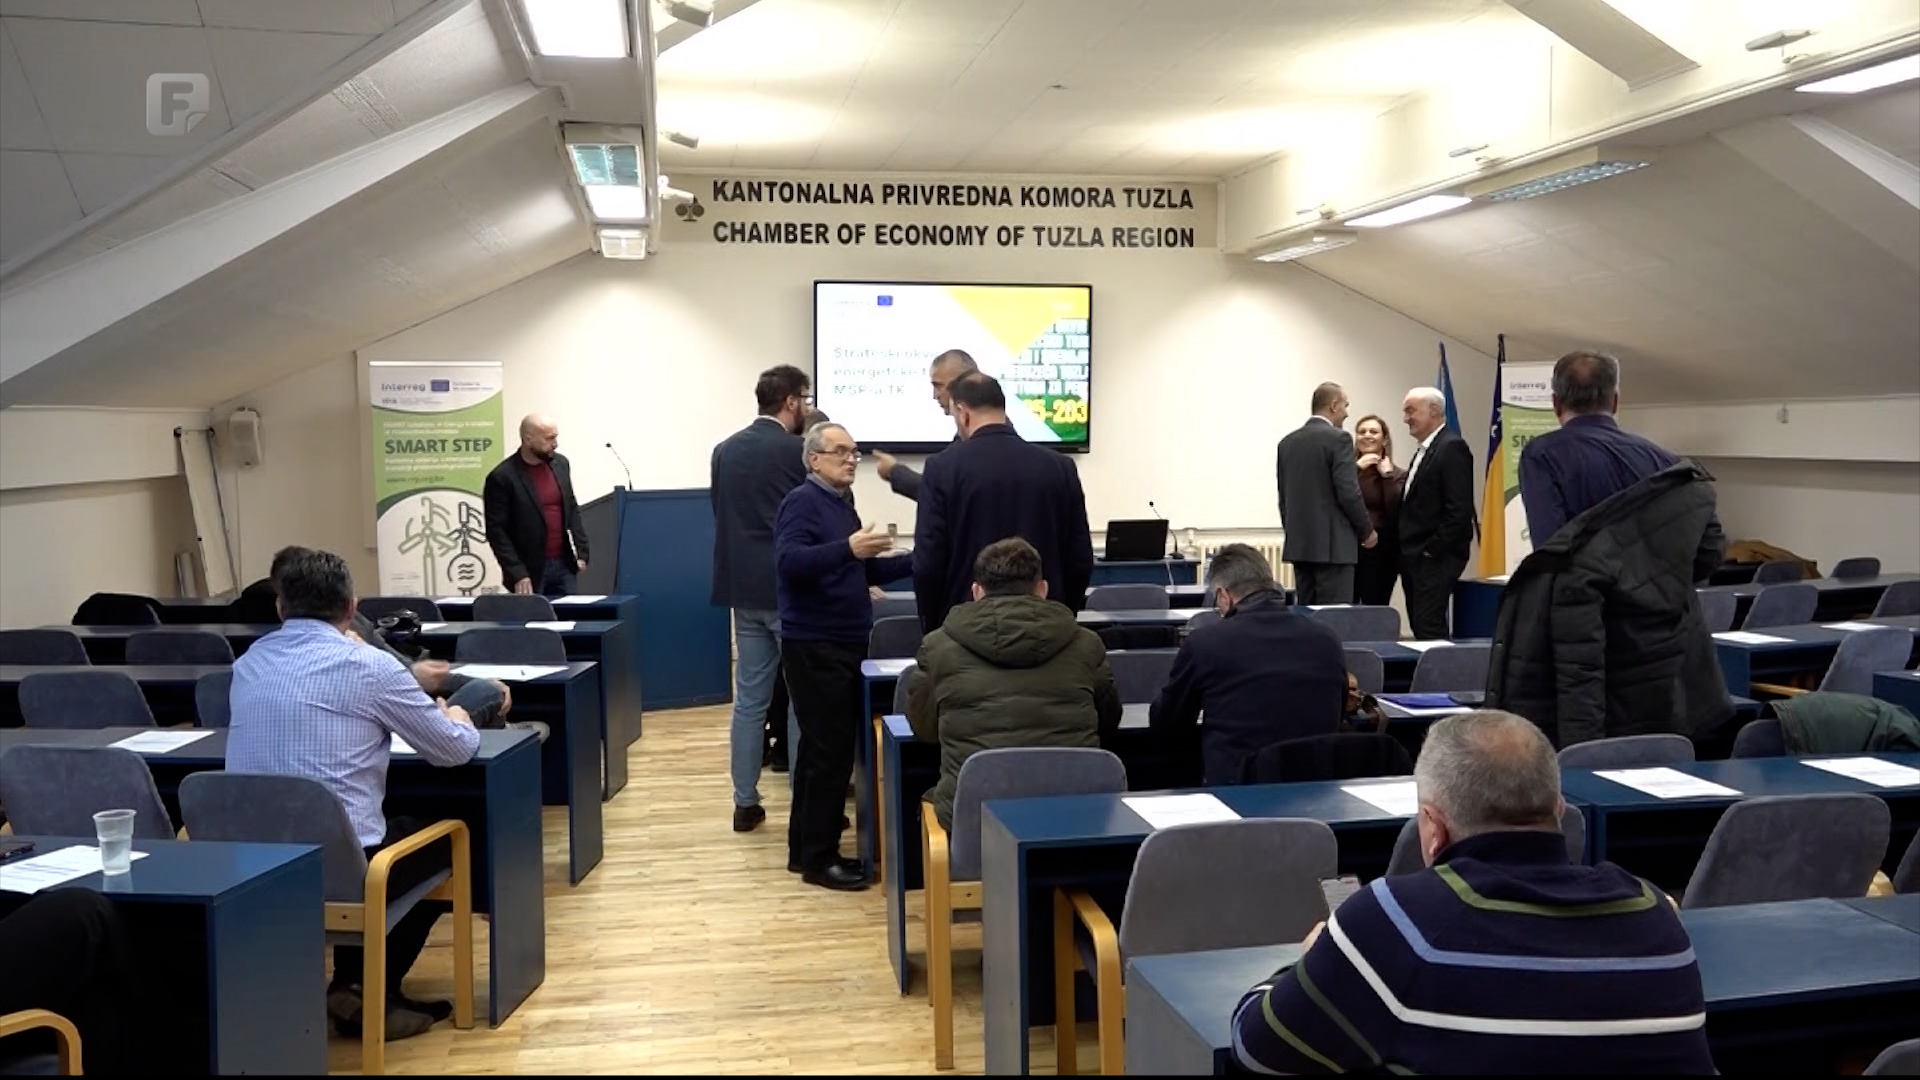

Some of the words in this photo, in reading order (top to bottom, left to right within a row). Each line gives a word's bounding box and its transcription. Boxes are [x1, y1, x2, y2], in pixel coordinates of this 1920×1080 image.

[712, 179, 875, 205] KANTONALNA
[882, 183, 1013, 206] PRIVREDNA
[1020, 187, 1116, 208] KOMORA
[1122, 187, 1194, 209] TUZLA
[713, 221, 830, 244] CHAMBER
[837, 223, 866, 244] OF
[874, 224, 989, 246] ECONOMY
[997, 225, 1025, 246] OF
[1033, 226, 1105, 248] TUZLA
[1112, 227, 1194, 248] REGION
[385, 438, 449, 455] SMART
[452, 437, 493, 453] STEP
